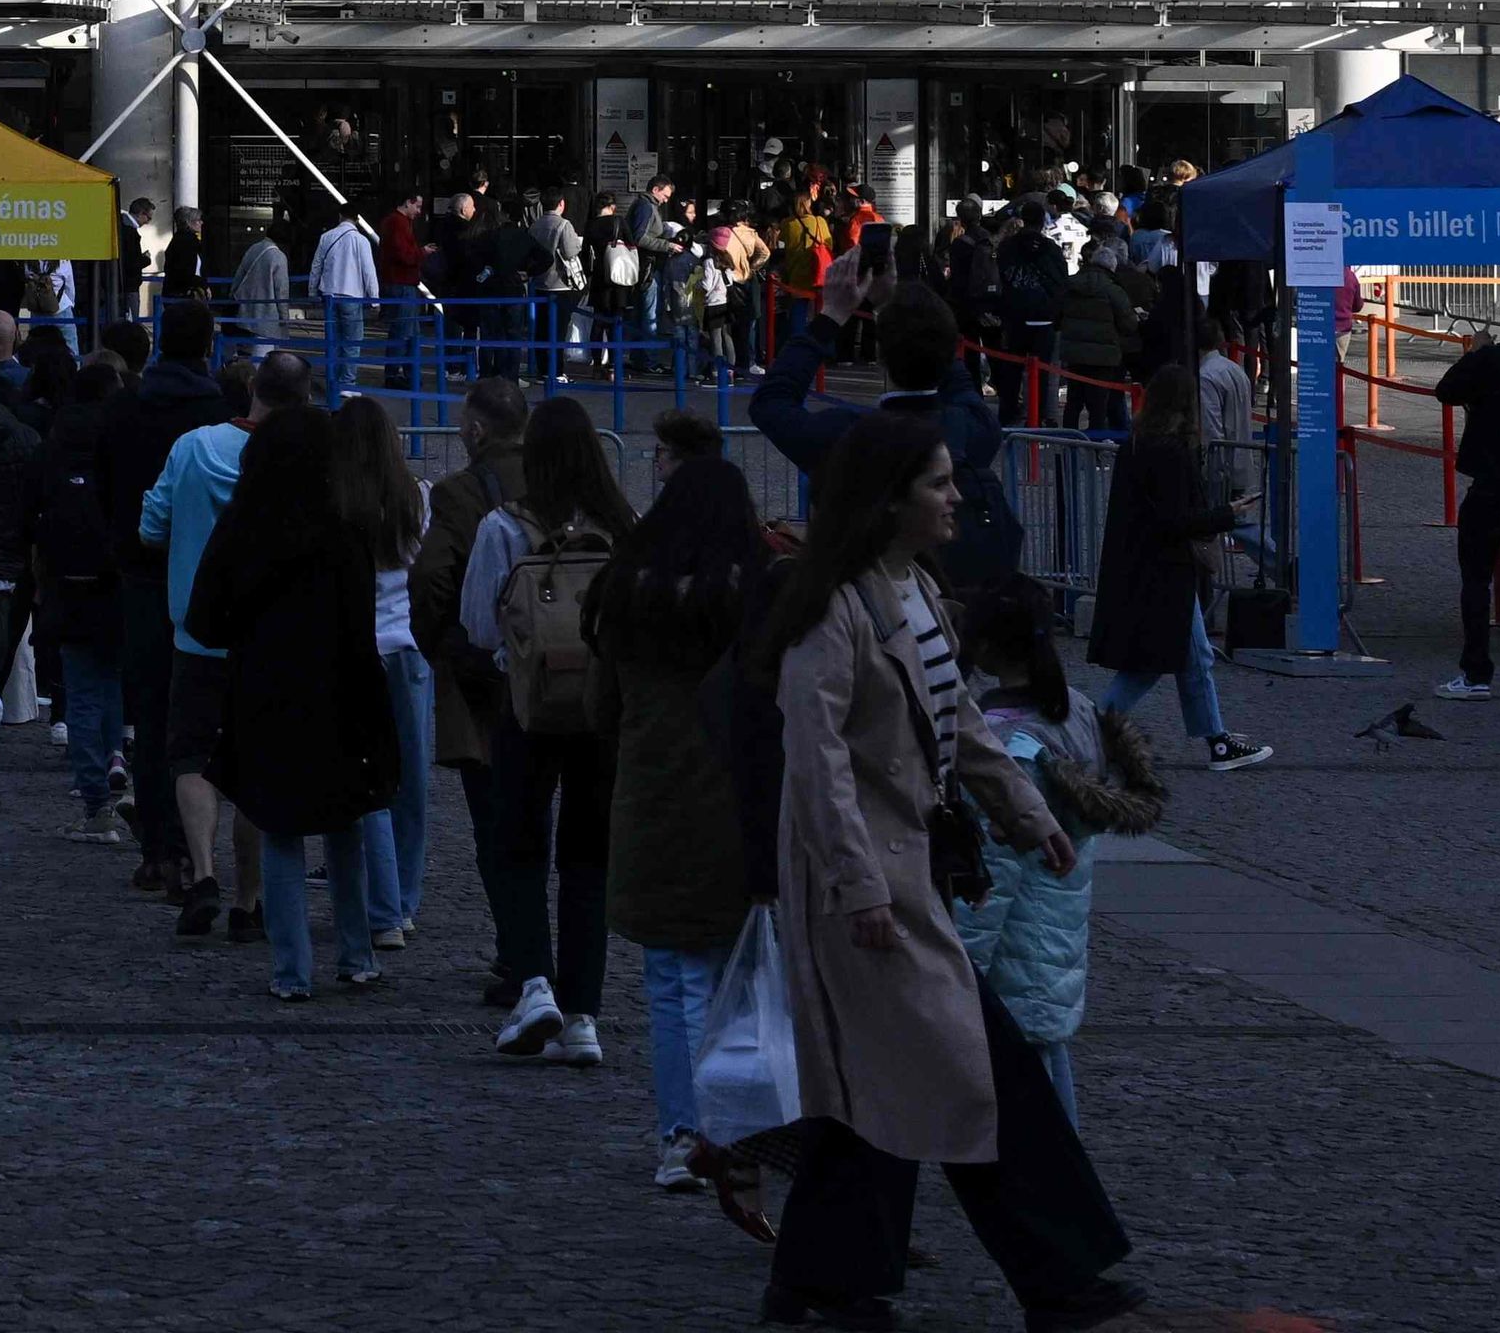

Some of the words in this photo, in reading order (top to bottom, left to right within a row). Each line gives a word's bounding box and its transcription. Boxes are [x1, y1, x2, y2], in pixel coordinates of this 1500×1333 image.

[510, 69, 518, 82] 3
[786, 69, 794, 83] 2
[1342, 211, 1399, 238] Sans
[1408, 210, 1475, 238] billet
